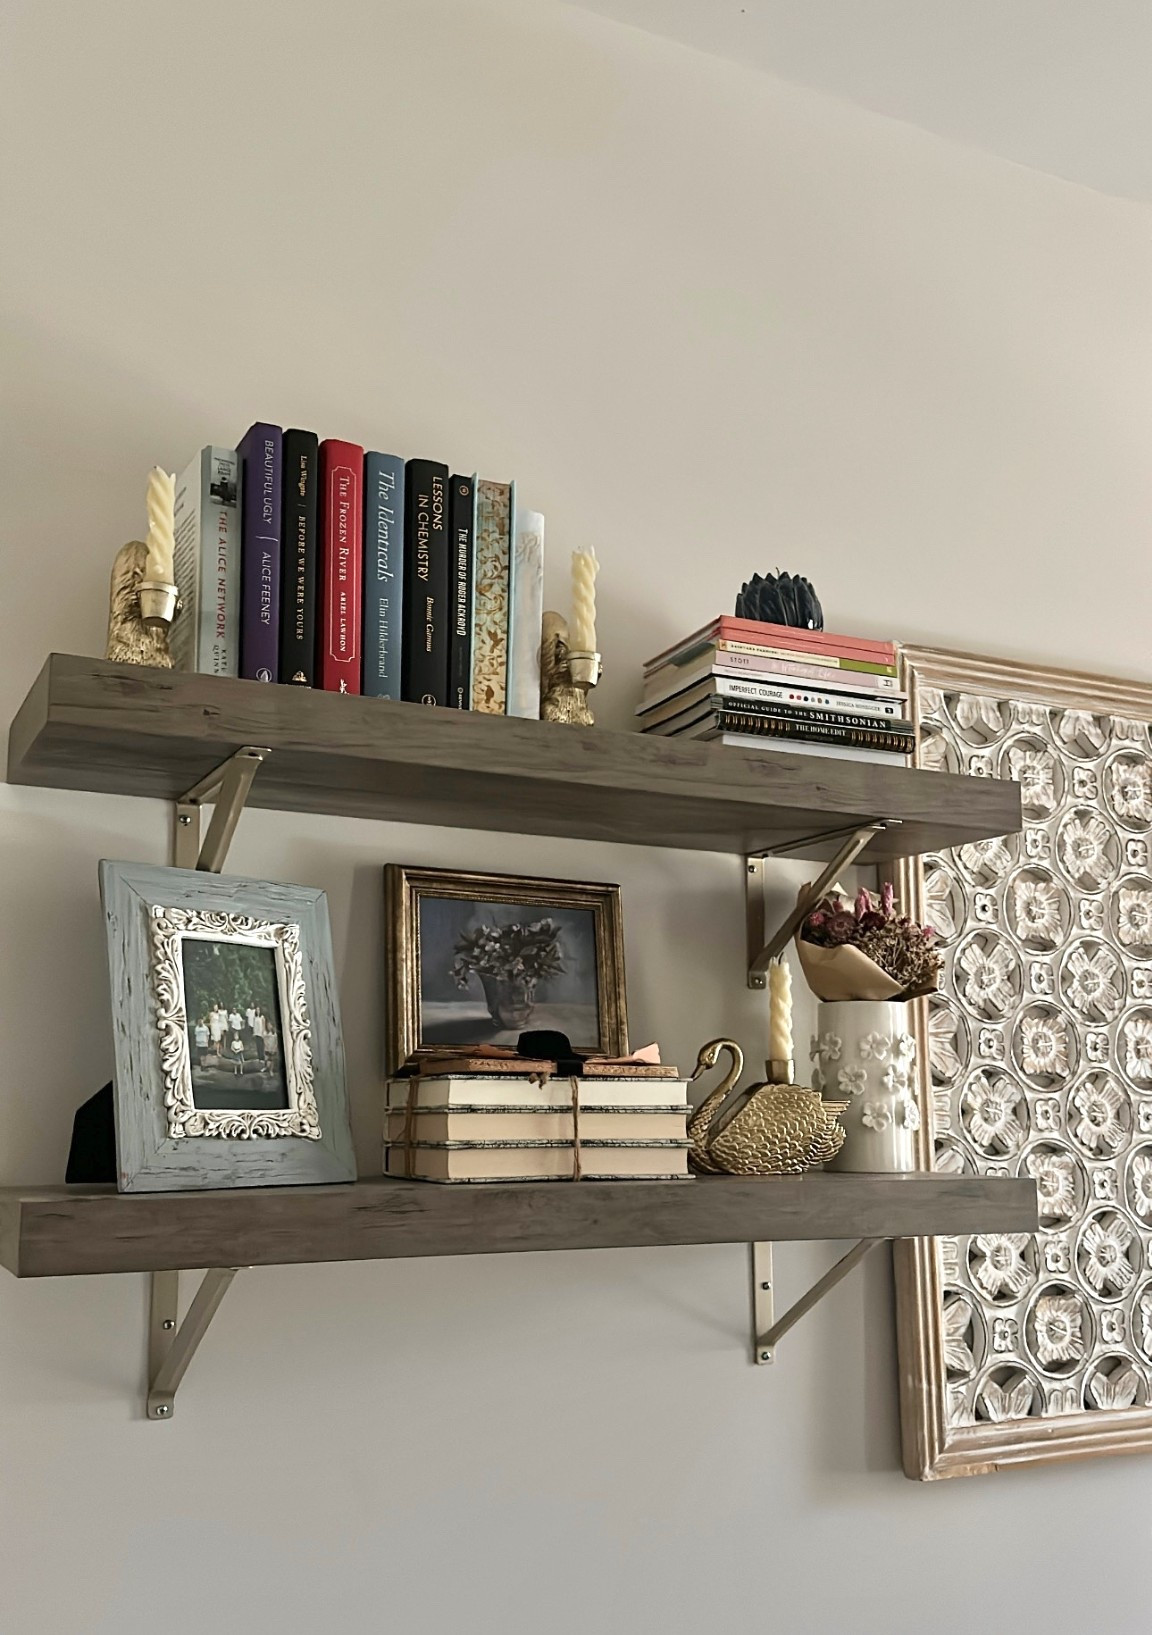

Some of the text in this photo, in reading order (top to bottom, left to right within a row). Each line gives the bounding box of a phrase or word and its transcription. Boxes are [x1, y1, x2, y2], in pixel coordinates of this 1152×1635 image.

[263, 440, 274, 524] BEAUTIFUL UGLY
[432, 476, 443, 531] LESSONS
[339, 476, 350, 581] THE FROZEN RIVER
[377, 470, 395, 583] The Identicals
[417, 494, 429, 582] IN CHEMISTRY
[458, 528, 468, 543] THE
[216, 511, 228, 639] THE ALICE NETWORK
[296, 516, 306, 640] BEFORE WE WERE YOURS
[457, 543, 467, 570] MURDER
[457, 571, 467, 581] OF
[260, 552, 271, 625] ALICE FEENEY
[426, 596, 434, 622] Bonnie
[457, 581, 467, 603] ROGER
[378, 598, 389, 678] Elin Hilderbrand
[457, 603, 467, 636] ACKROYD
[729, 684, 783, 699] IMPERFECT COURAGE
[728, 701, 760, 710] OFFICIAL
[761, 706, 782, 714] GUIDE
[809, 711, 887, 728] SMITHSONIAN
[795, 723, 847, 737] THE HOME EDIT
